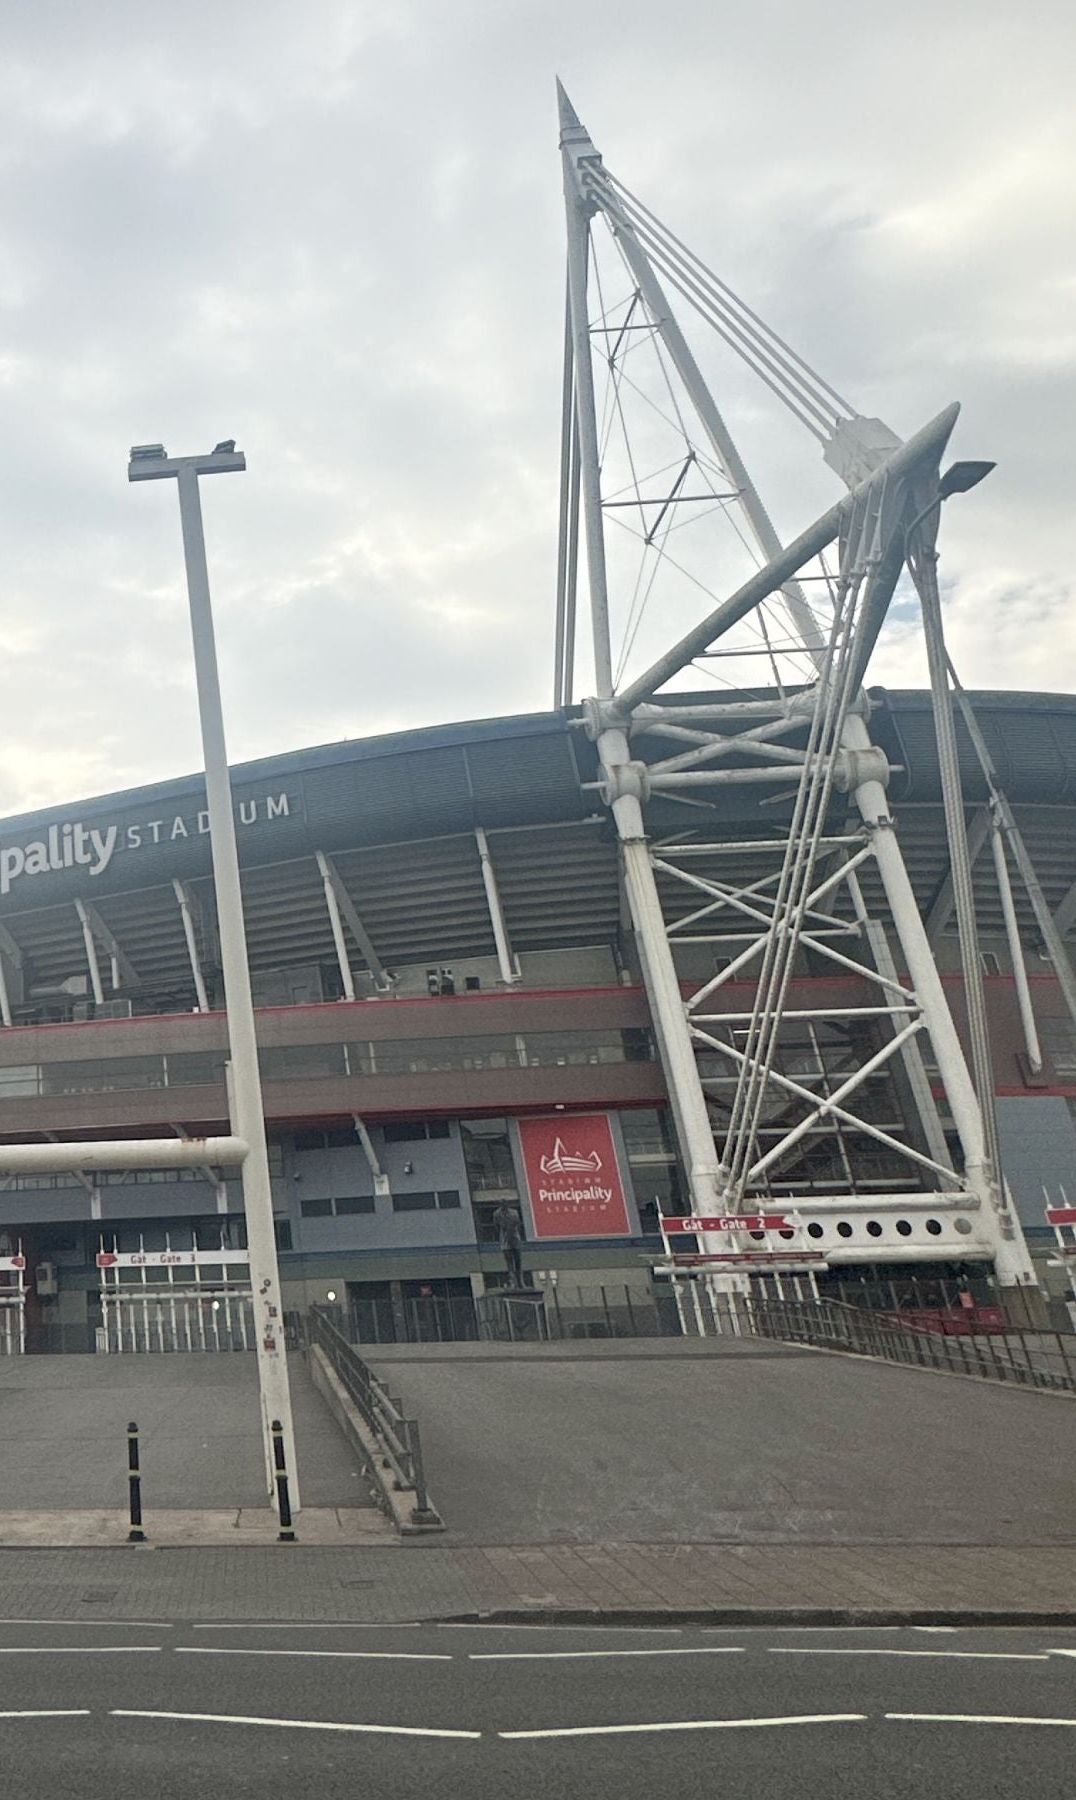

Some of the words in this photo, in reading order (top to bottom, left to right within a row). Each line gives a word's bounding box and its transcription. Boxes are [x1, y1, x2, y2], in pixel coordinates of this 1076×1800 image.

[126, 792, 291, 850] STADUM
[538, 1185, 613, 1204] Principality
[719, 1217, 748, 1230] Gate
[756, 1217, 766, 1229] 2
[159, 1253, 181, 1263] Gate
[189, 1253, 196, 1262] 3
